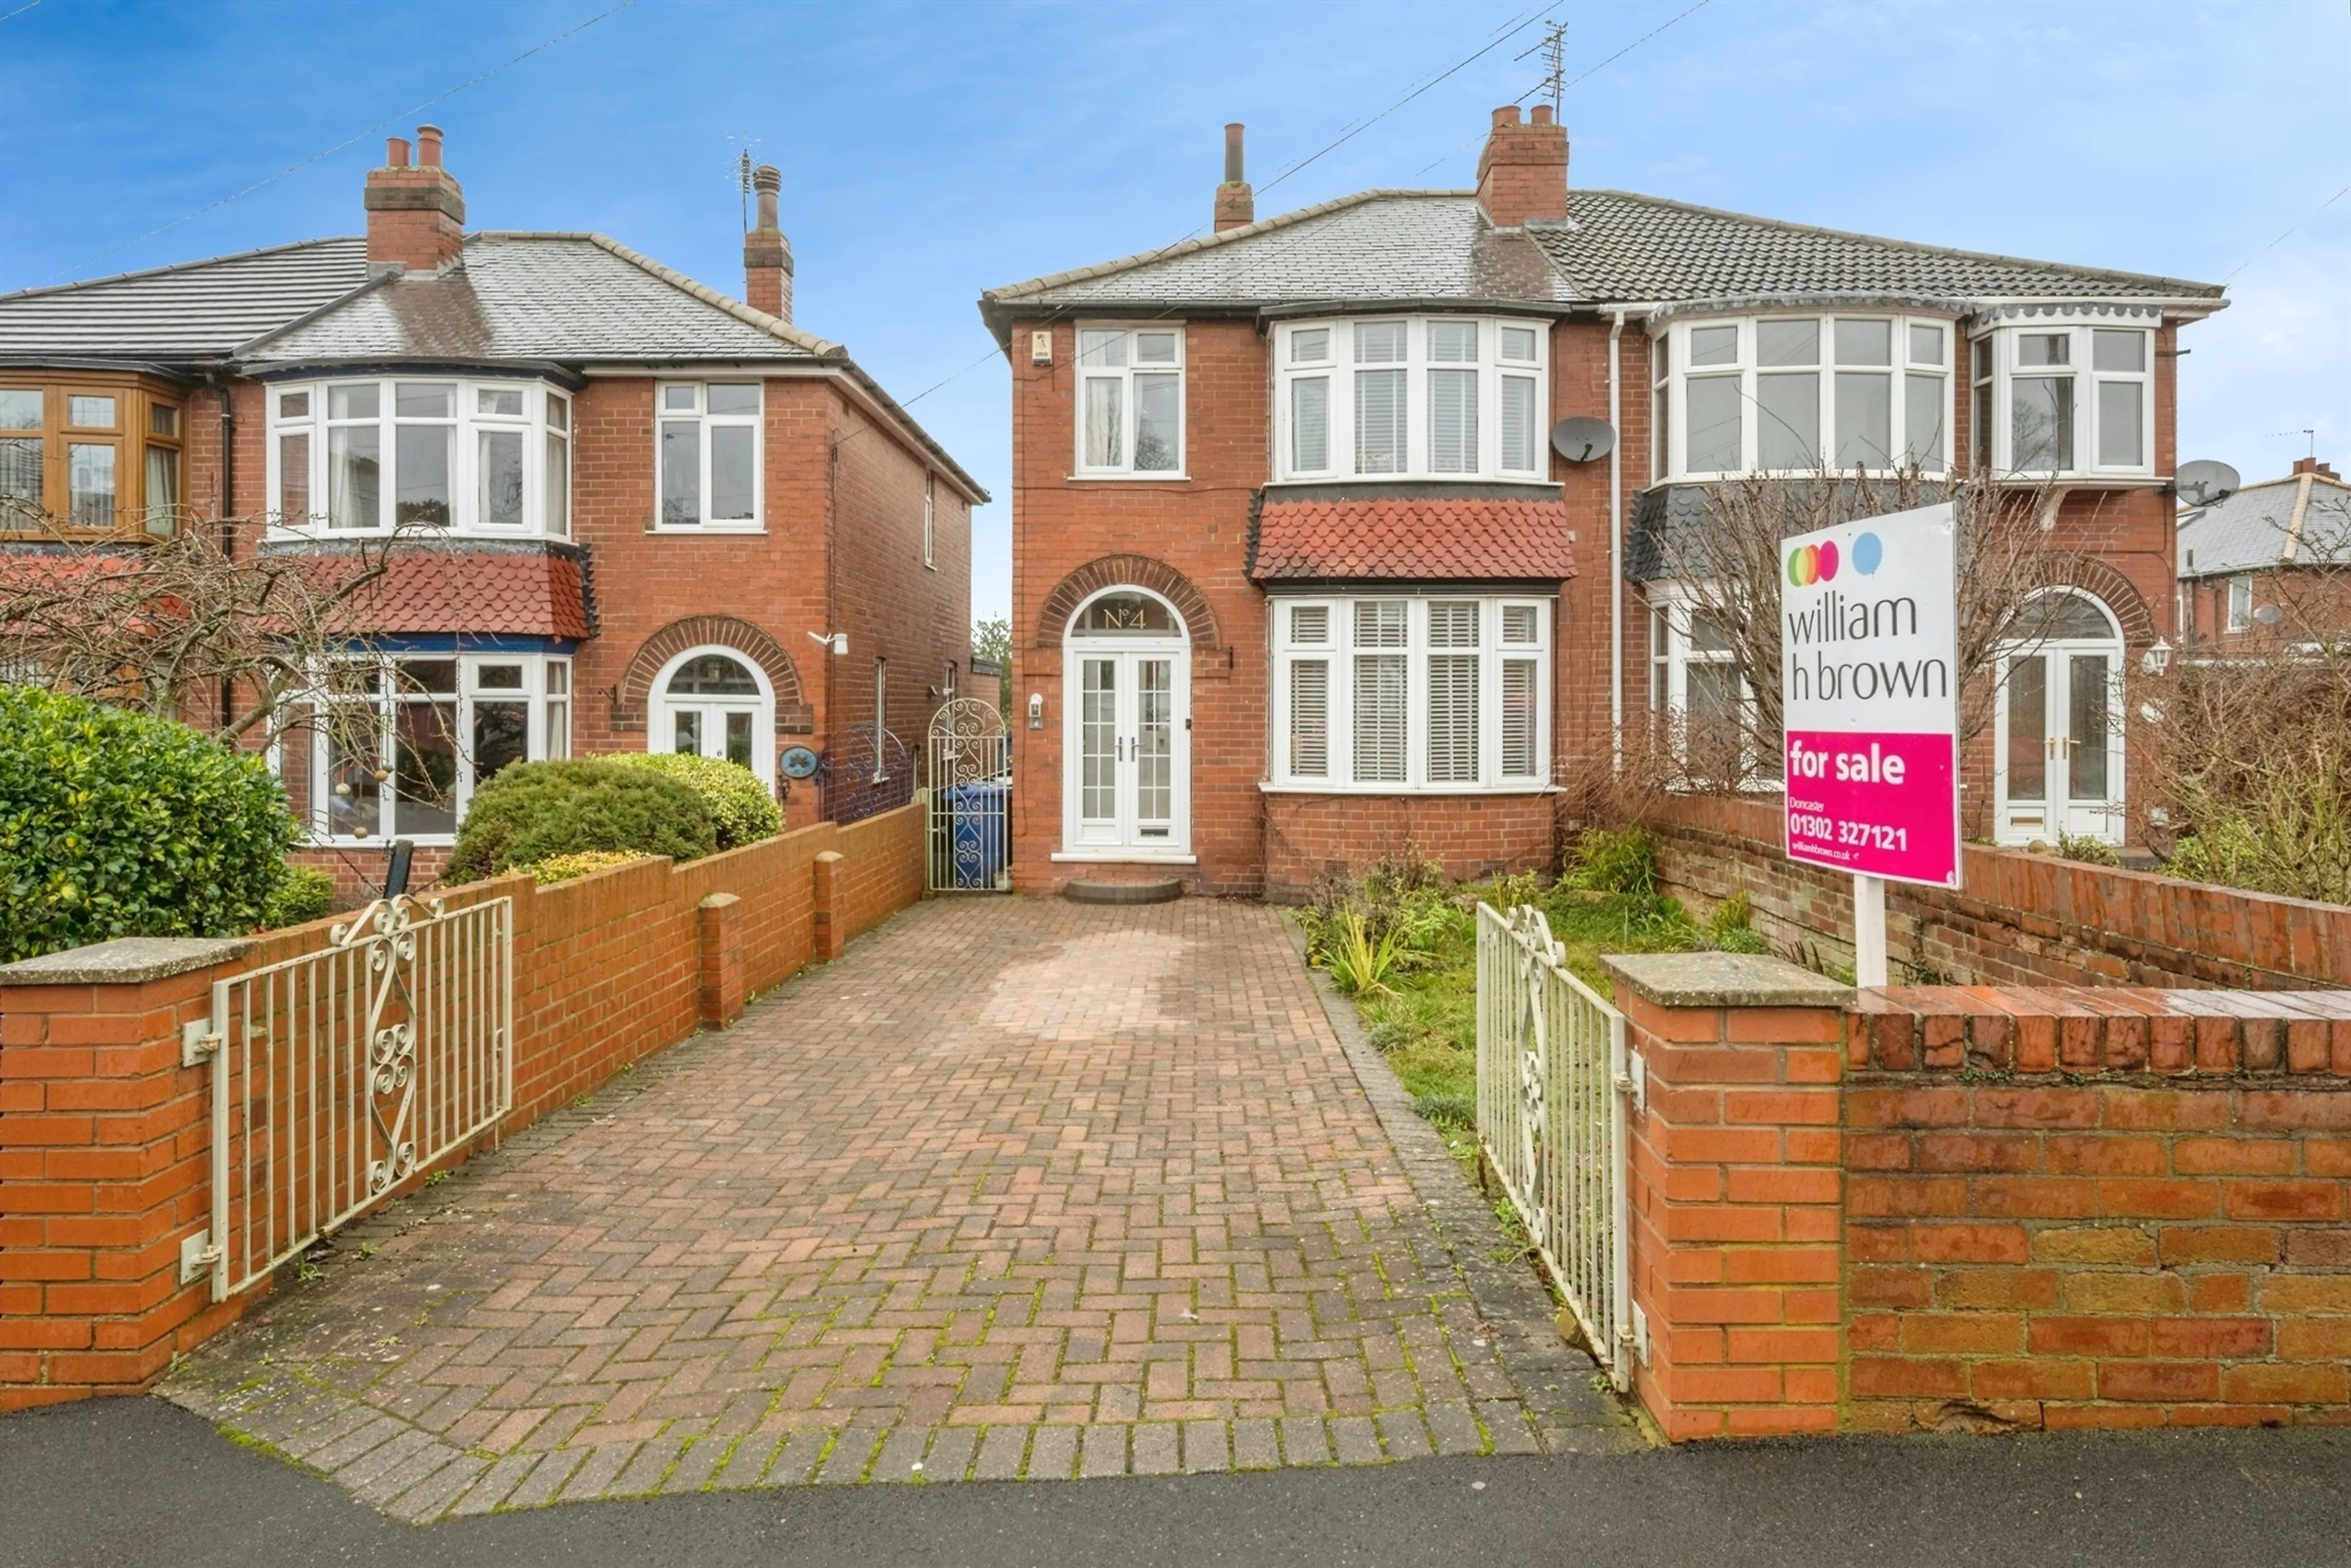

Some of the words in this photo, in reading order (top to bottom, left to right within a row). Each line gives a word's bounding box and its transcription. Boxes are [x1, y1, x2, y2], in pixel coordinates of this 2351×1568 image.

[1788, 590, 1916, 645] william
[1793, 653, 1809, 700] h
[1818, 651, 1947, 700] brown
[1790, 740, 1829, 779] for
[1835, 743, 1905, 785] sale
[1789, 797, 1824, 812] Doncaster
[1790, 813, 1833, 841] 01302
[1838, 820, 1907, 852] 327121
